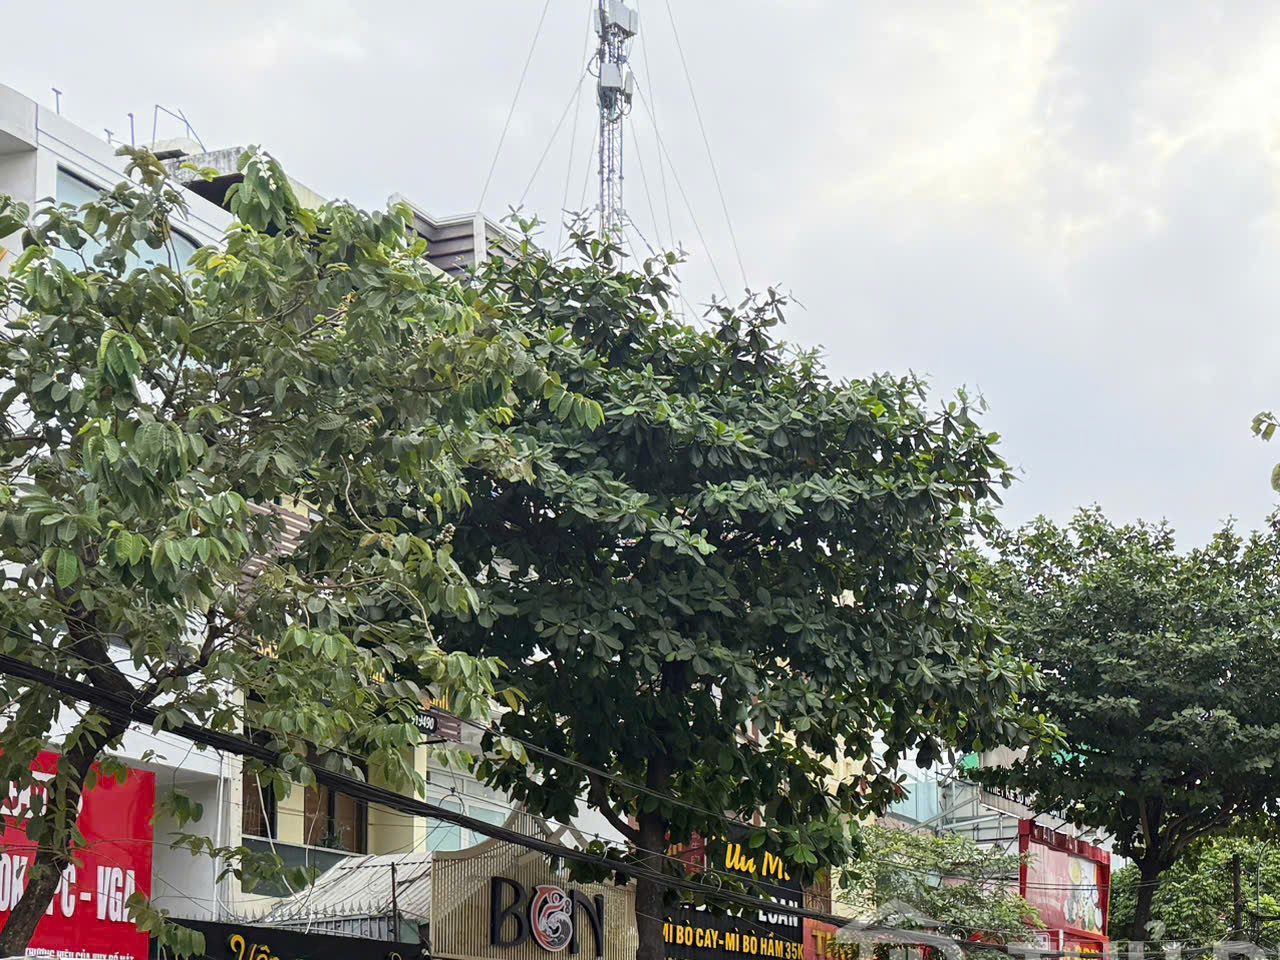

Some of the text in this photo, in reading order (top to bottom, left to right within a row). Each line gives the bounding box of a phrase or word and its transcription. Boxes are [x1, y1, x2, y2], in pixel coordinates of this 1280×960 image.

[97, 866, 137, 924] VGA
[676, 919, 694, 946] BÒ
[742, 929, 758, 955] BÒ
[785, 942, 804, 960] 35K
